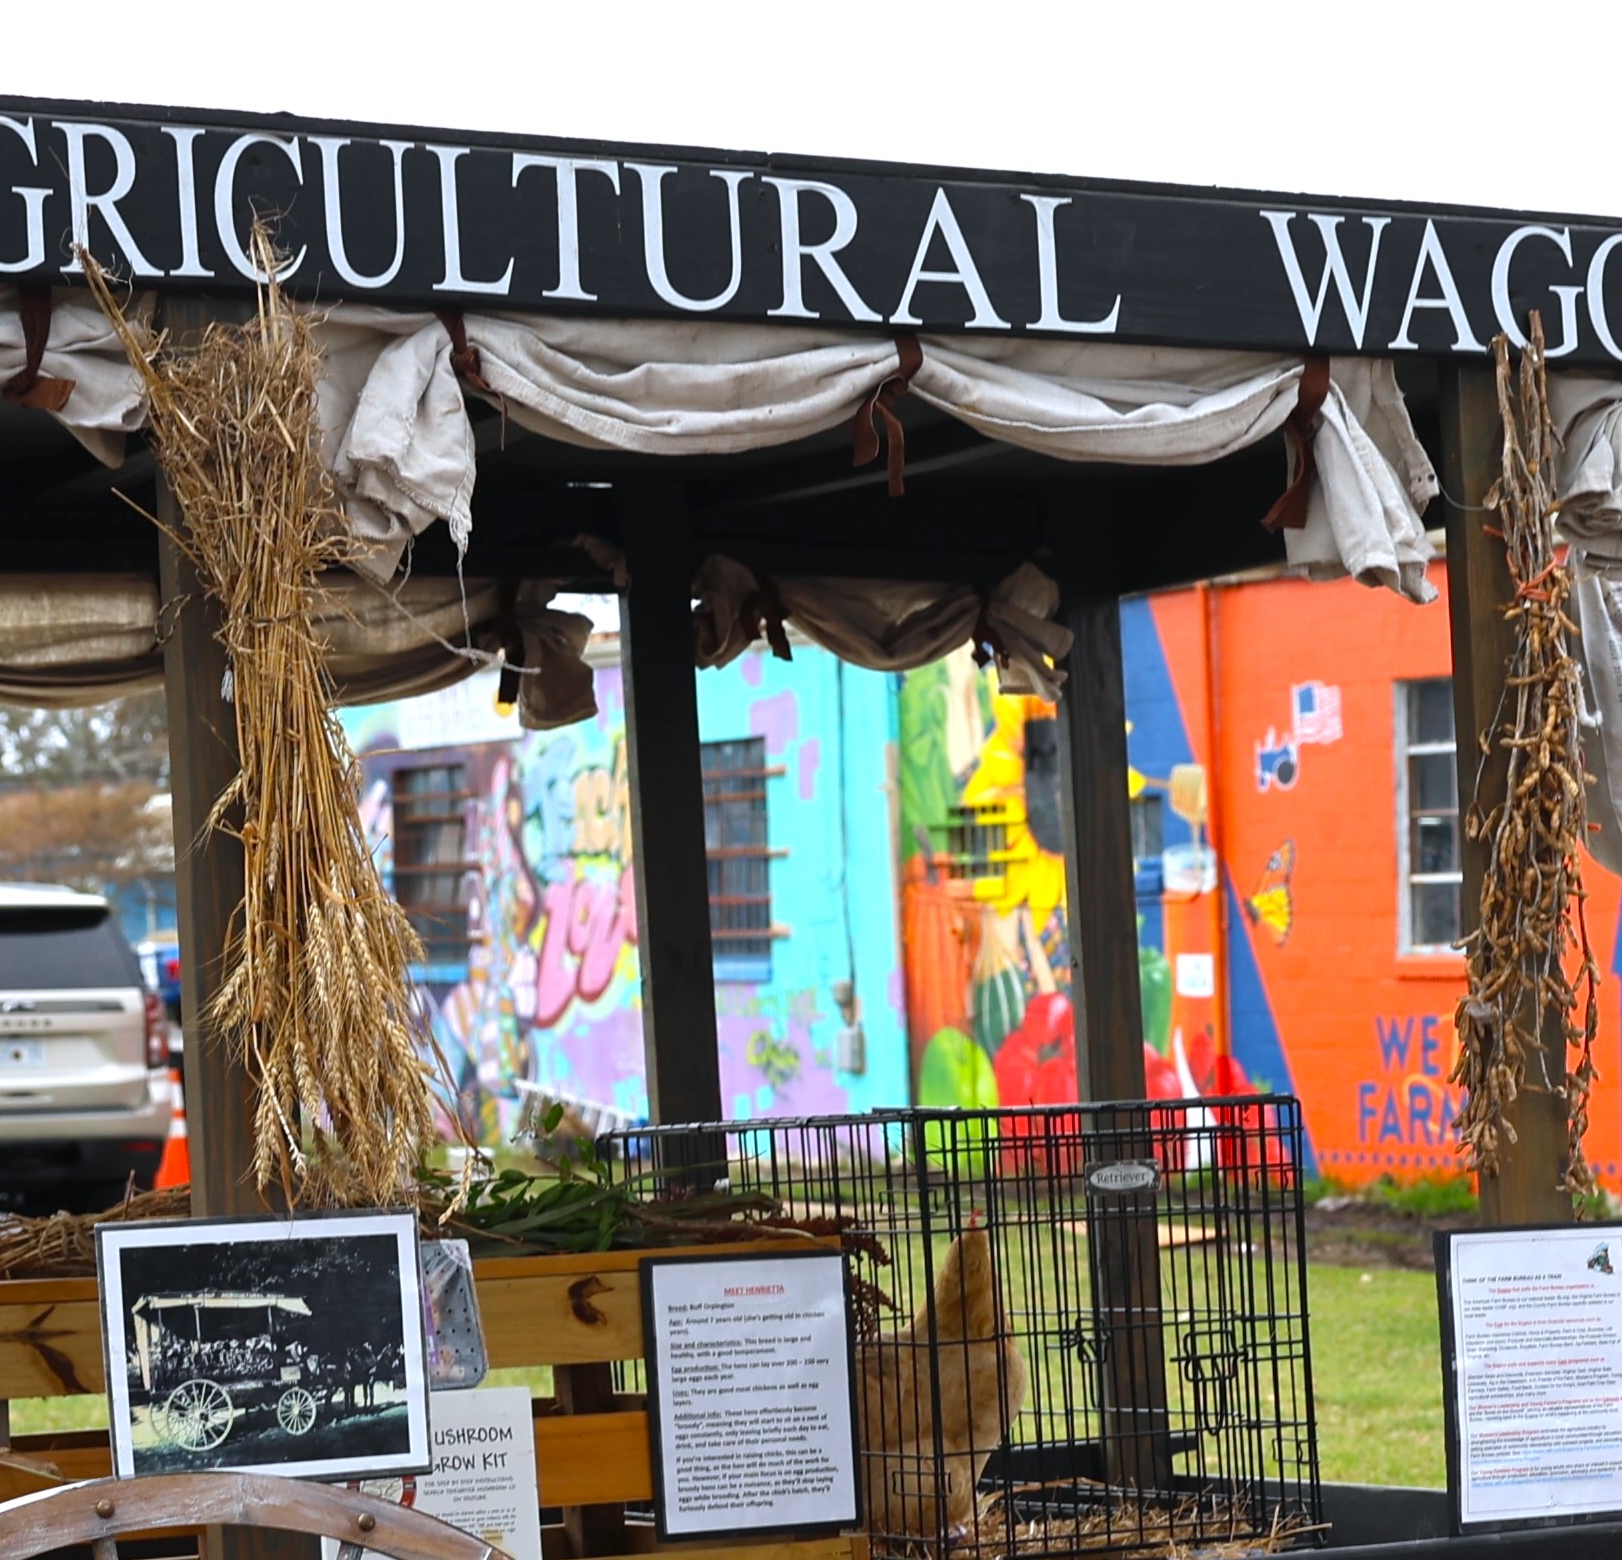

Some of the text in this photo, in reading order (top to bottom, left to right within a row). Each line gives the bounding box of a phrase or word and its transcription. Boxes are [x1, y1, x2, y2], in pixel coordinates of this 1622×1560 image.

[1375, 1015, 1440, 1076] WE
[1097, 1171, 1146, 1184] Retriever
[724, 1284, 784, 1295] MEET HENRIETTA
[435, 1426, 513, 1446] USHROOM
[483, 1452, 507, 1470] KIT
